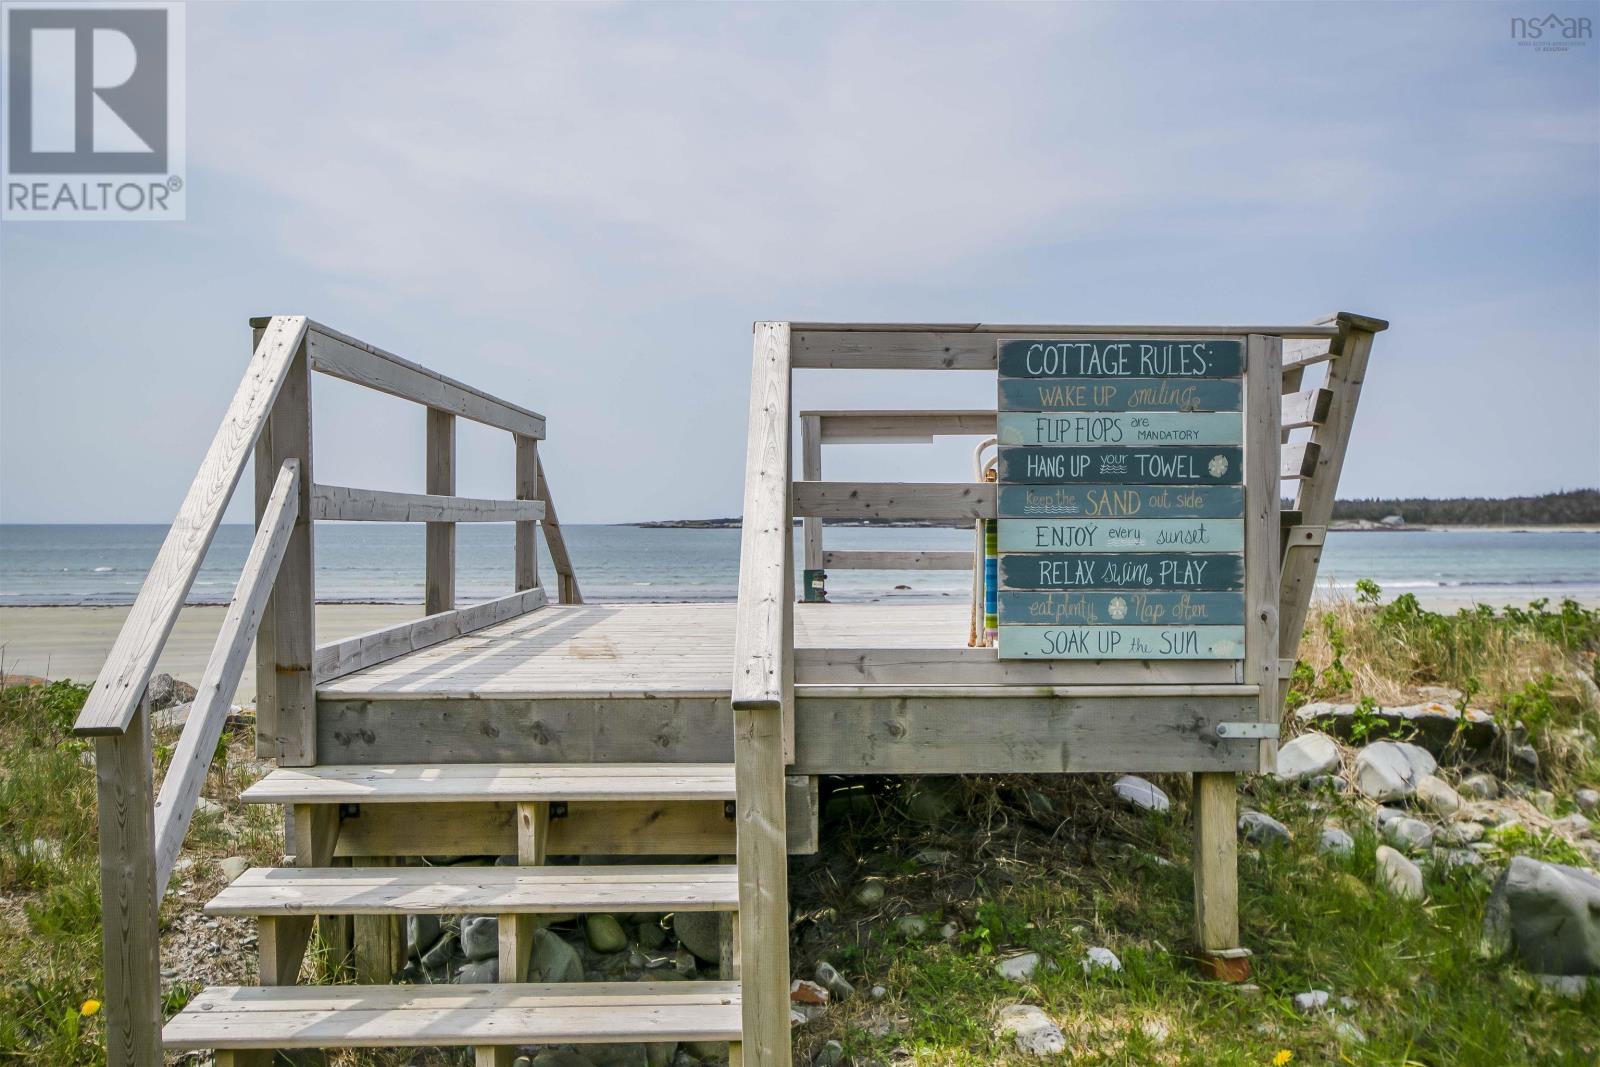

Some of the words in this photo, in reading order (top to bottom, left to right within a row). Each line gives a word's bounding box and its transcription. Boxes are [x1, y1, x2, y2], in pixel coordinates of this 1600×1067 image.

[1026, 343, 1132, 376] COTTAGE
[1140, 343, 1214, 376] RULES:
[1038, 386, 1087, 406] WAKE
[1093, 386, 1116, 406] UP
[1037, 418, 1071, 443] FLIP
[1076, 418, 1122, 443] FLOPS
[1131, 417, 1149, 427] are
[1138, 431, 1199, 440] MANDATORY
[1027, 455, 1064, 477] HANG
[1071, 455, 1090, 477] UP
[1101, 455, 1128, 466] your
[1134, 455, 1200, 478] TOWEL
[1056, 490, 1075, 505] the
[1085, 491, 1141, 515] SAND
[1149, 492, 1171, 508] out
[1177, 492, 1203, 508] side
[1036, 526, 1098, 547] ENJOY
[1109, 528, 1141, 545] every
[1156, 523, 1209, 544] sunset
[1039, 561, 1095, 585] RELAX
[1101, 561, 1153, 585] swim
[1160, 560, 1208, 585] PLAY
[1029, 597, 1055, 616] eat
[1056, 597, 1098, 622] plenty
[1172, 594, 1208, 617] often
[1041, 630, 1090, 655] SOAK
[1098, 631, 1121, 653] UP
[1129, 638, 1152, 655] the
[1159, 631, 1199, 654] SUN
